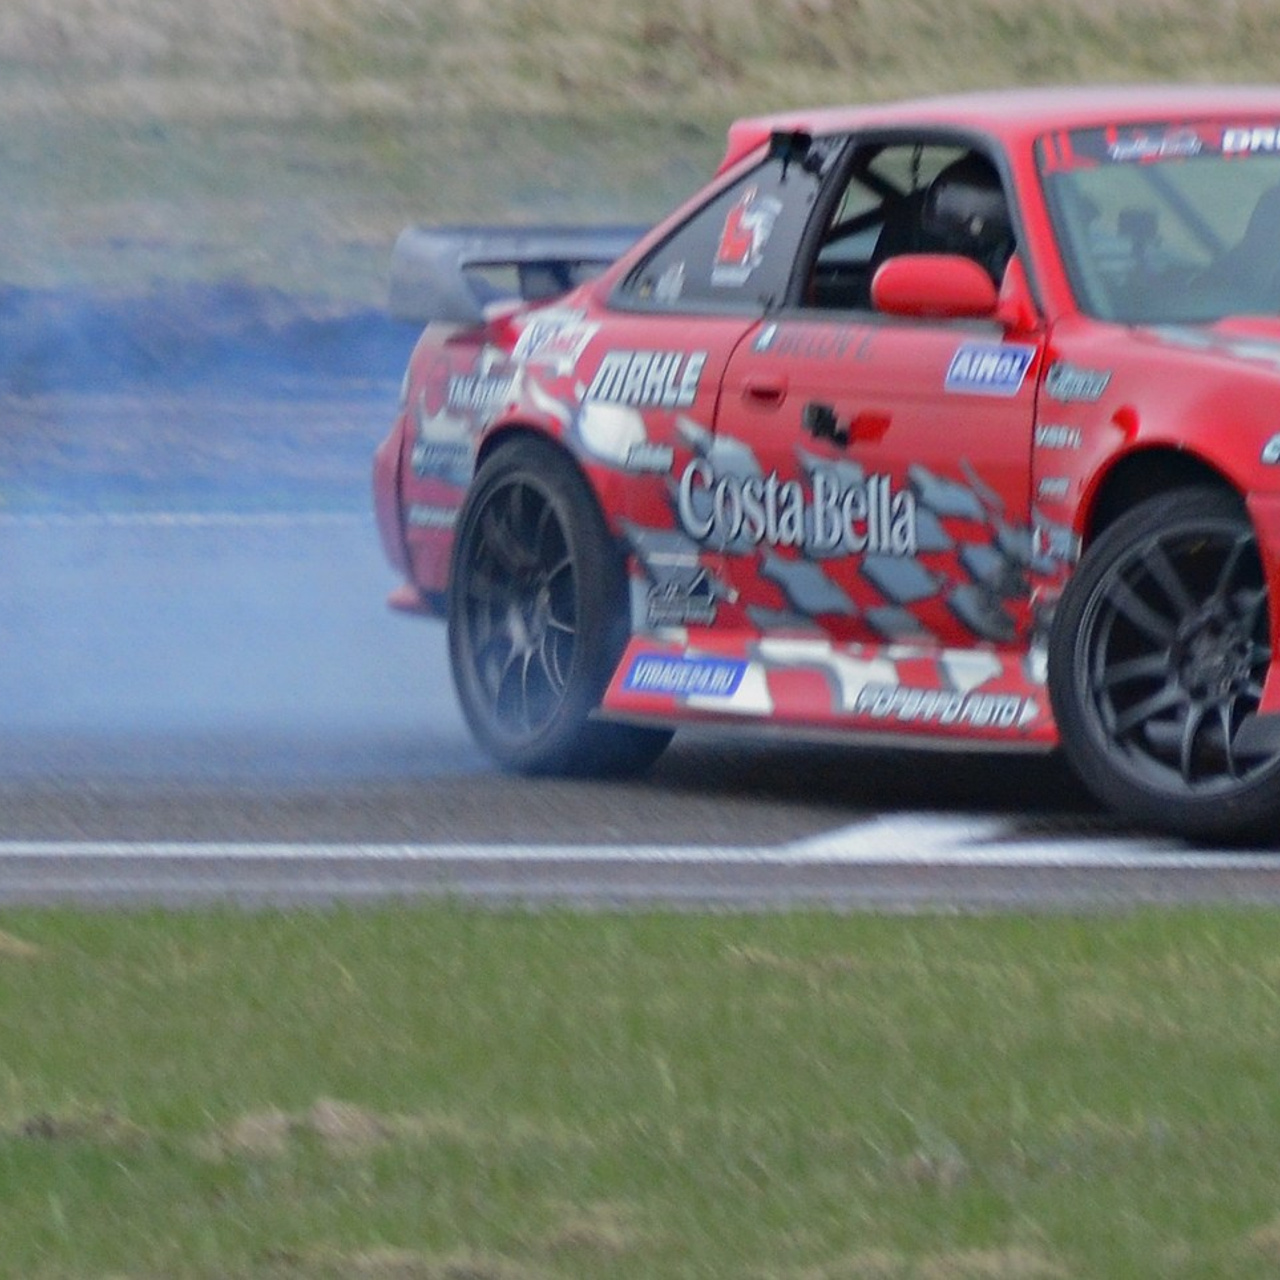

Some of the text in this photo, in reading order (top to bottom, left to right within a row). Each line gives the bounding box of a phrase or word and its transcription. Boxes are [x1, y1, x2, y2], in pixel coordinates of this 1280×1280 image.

[586, 349, 708, 409] MAHLE
[678, 458, 917, 557] Costa Bella
